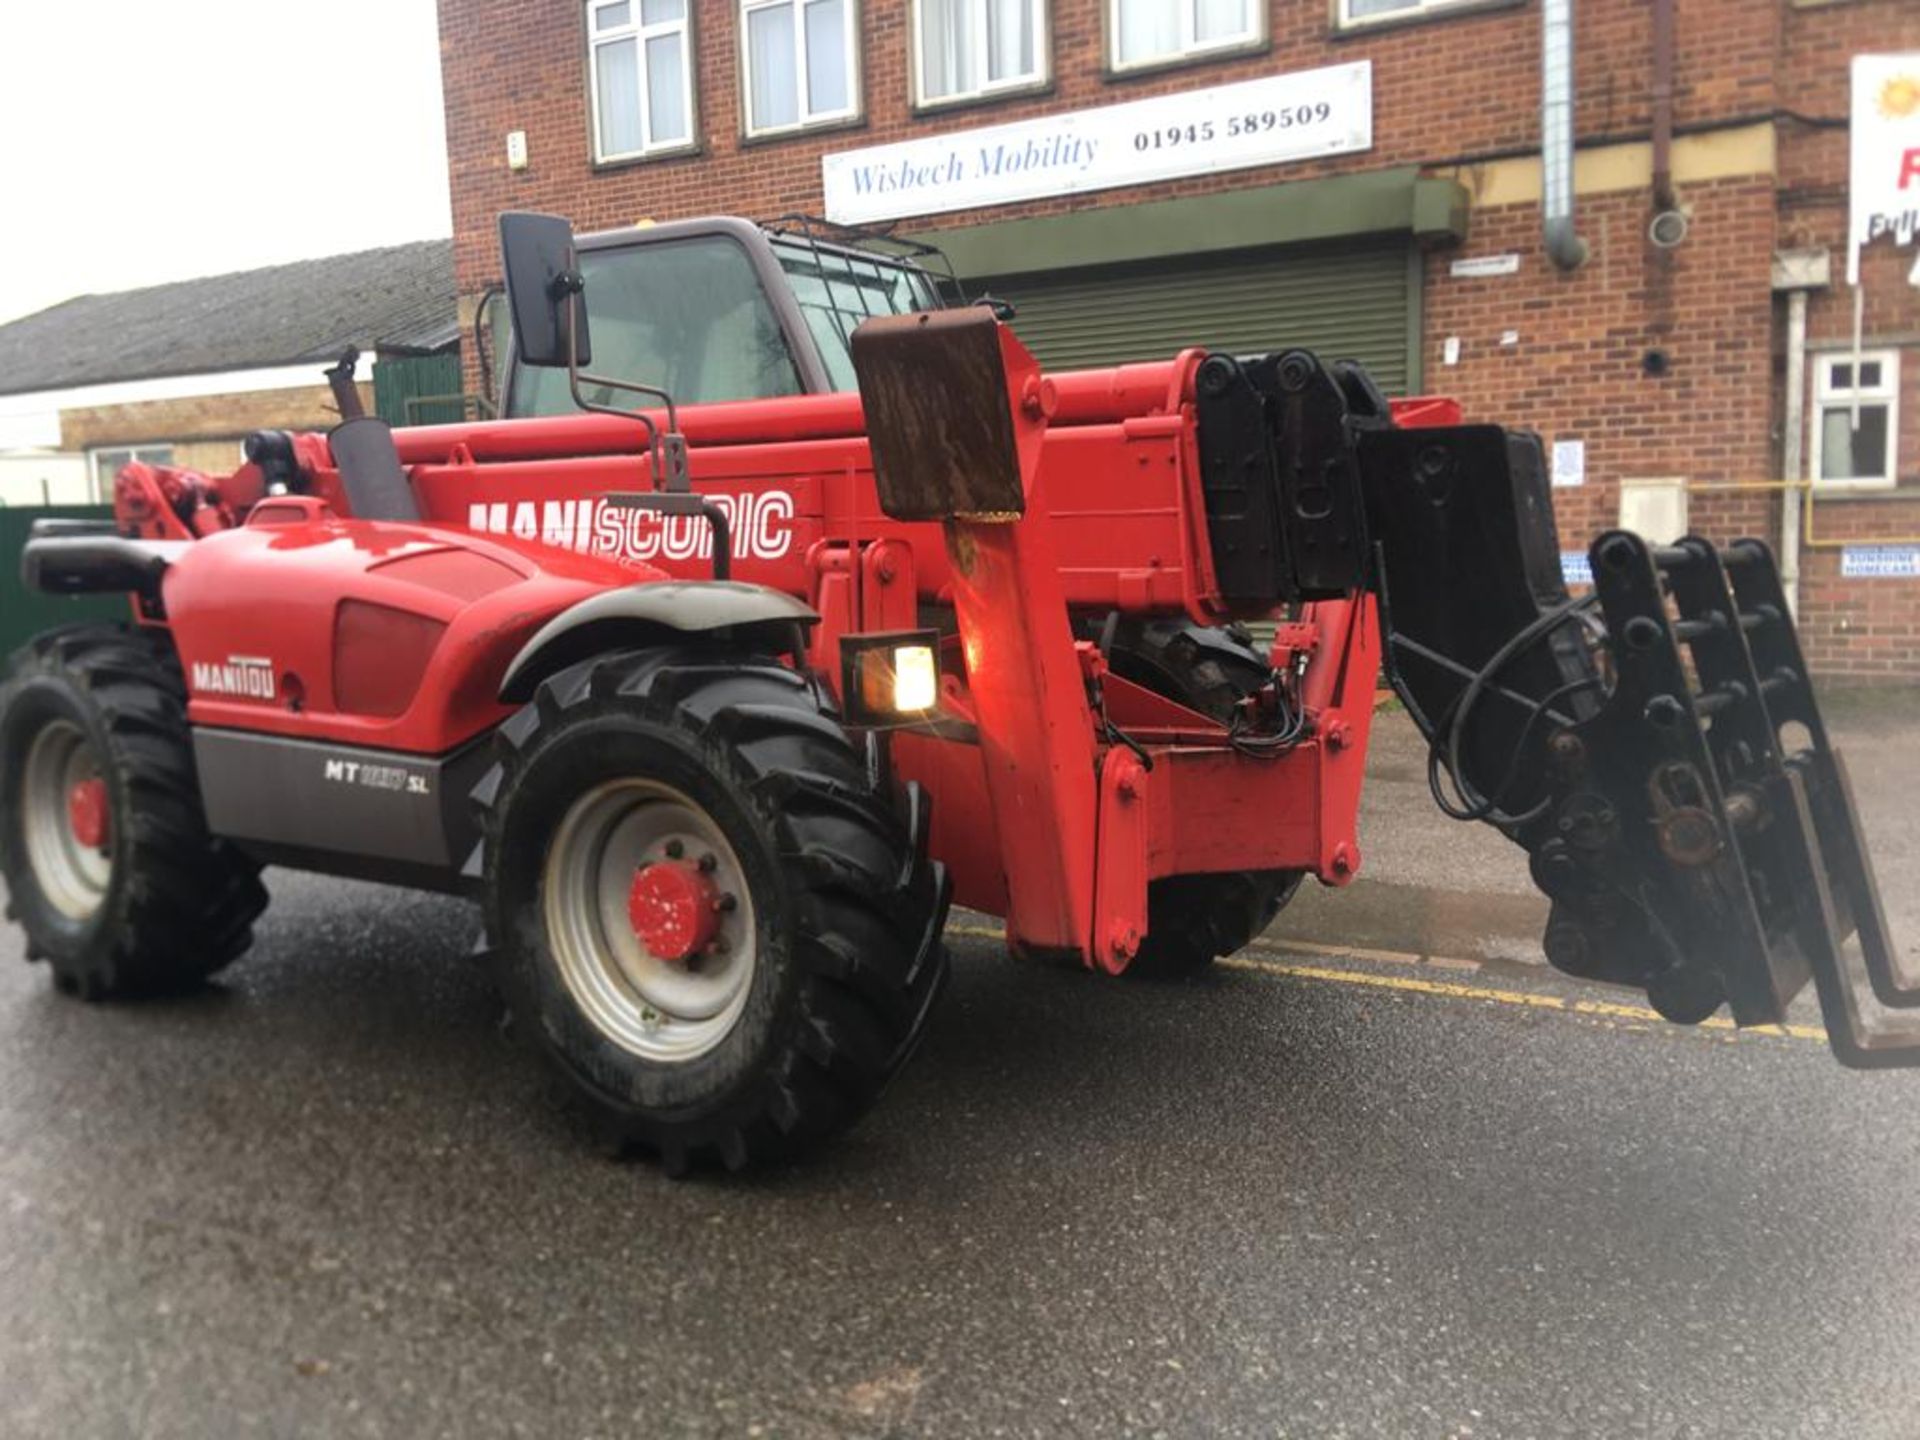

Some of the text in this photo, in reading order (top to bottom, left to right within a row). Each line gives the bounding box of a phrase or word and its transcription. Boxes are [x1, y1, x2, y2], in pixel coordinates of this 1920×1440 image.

[853, 102, 1330, 195] Wisbech Mobility 01945 589509
[193, 655, 275, 698] MANITOU
[324, 758, 360, 783] MT
[406, 775, 430, 794] SL
